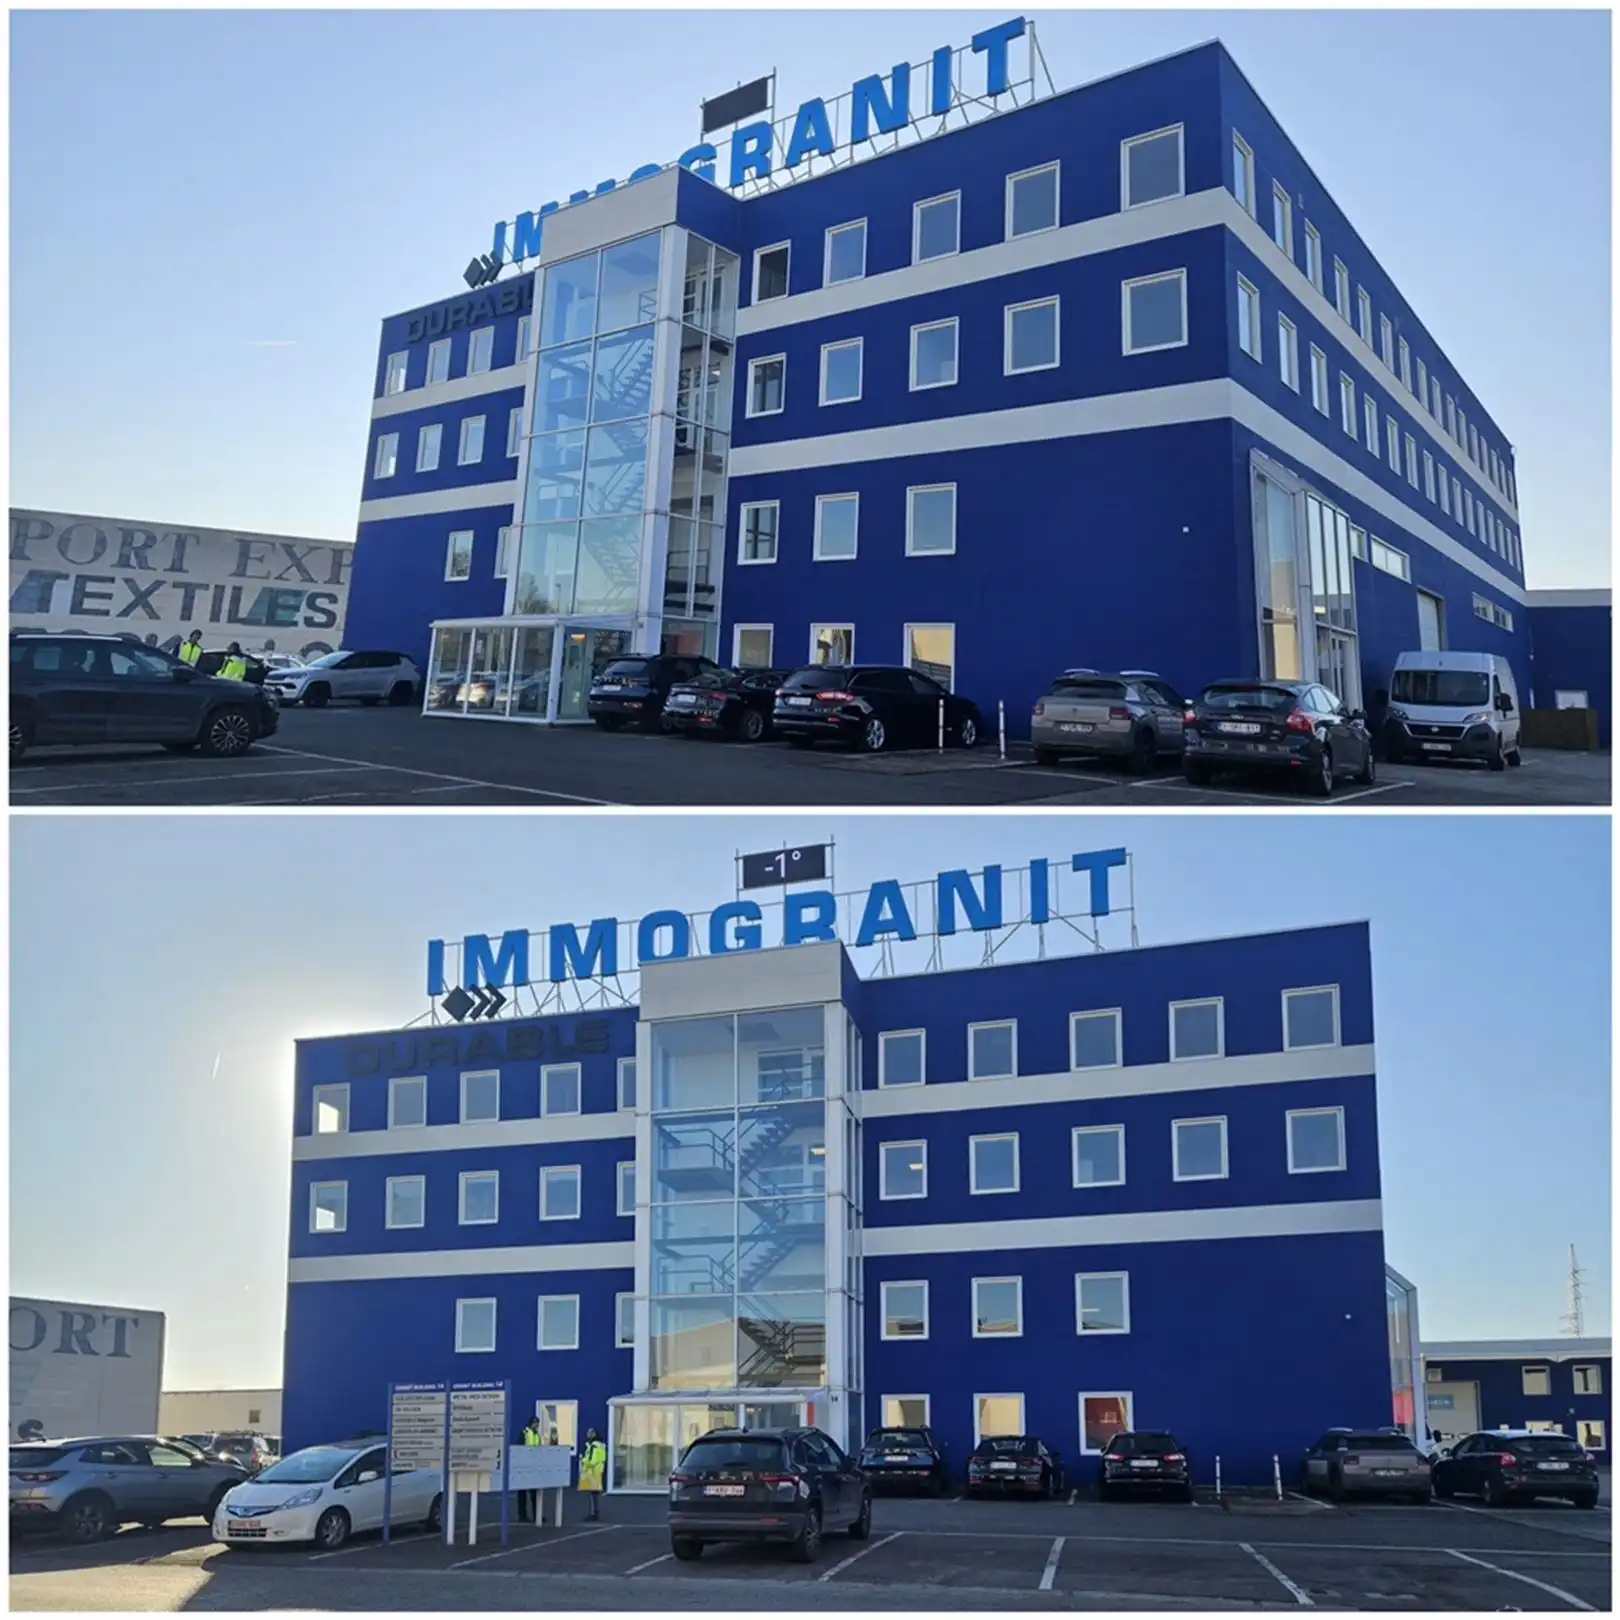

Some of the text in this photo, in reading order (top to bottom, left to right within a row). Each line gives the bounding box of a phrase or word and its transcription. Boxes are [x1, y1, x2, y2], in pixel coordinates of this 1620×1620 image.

[494, 16, 1026, 262] IMGRANIT
[406, 280, 533, 343] DURABL
[24, 568, 339, 629] TEXTILES
[427, 847, 1127, 996] IMMOGRANIT
[344, 1018, 611, 1075] DURABLE
